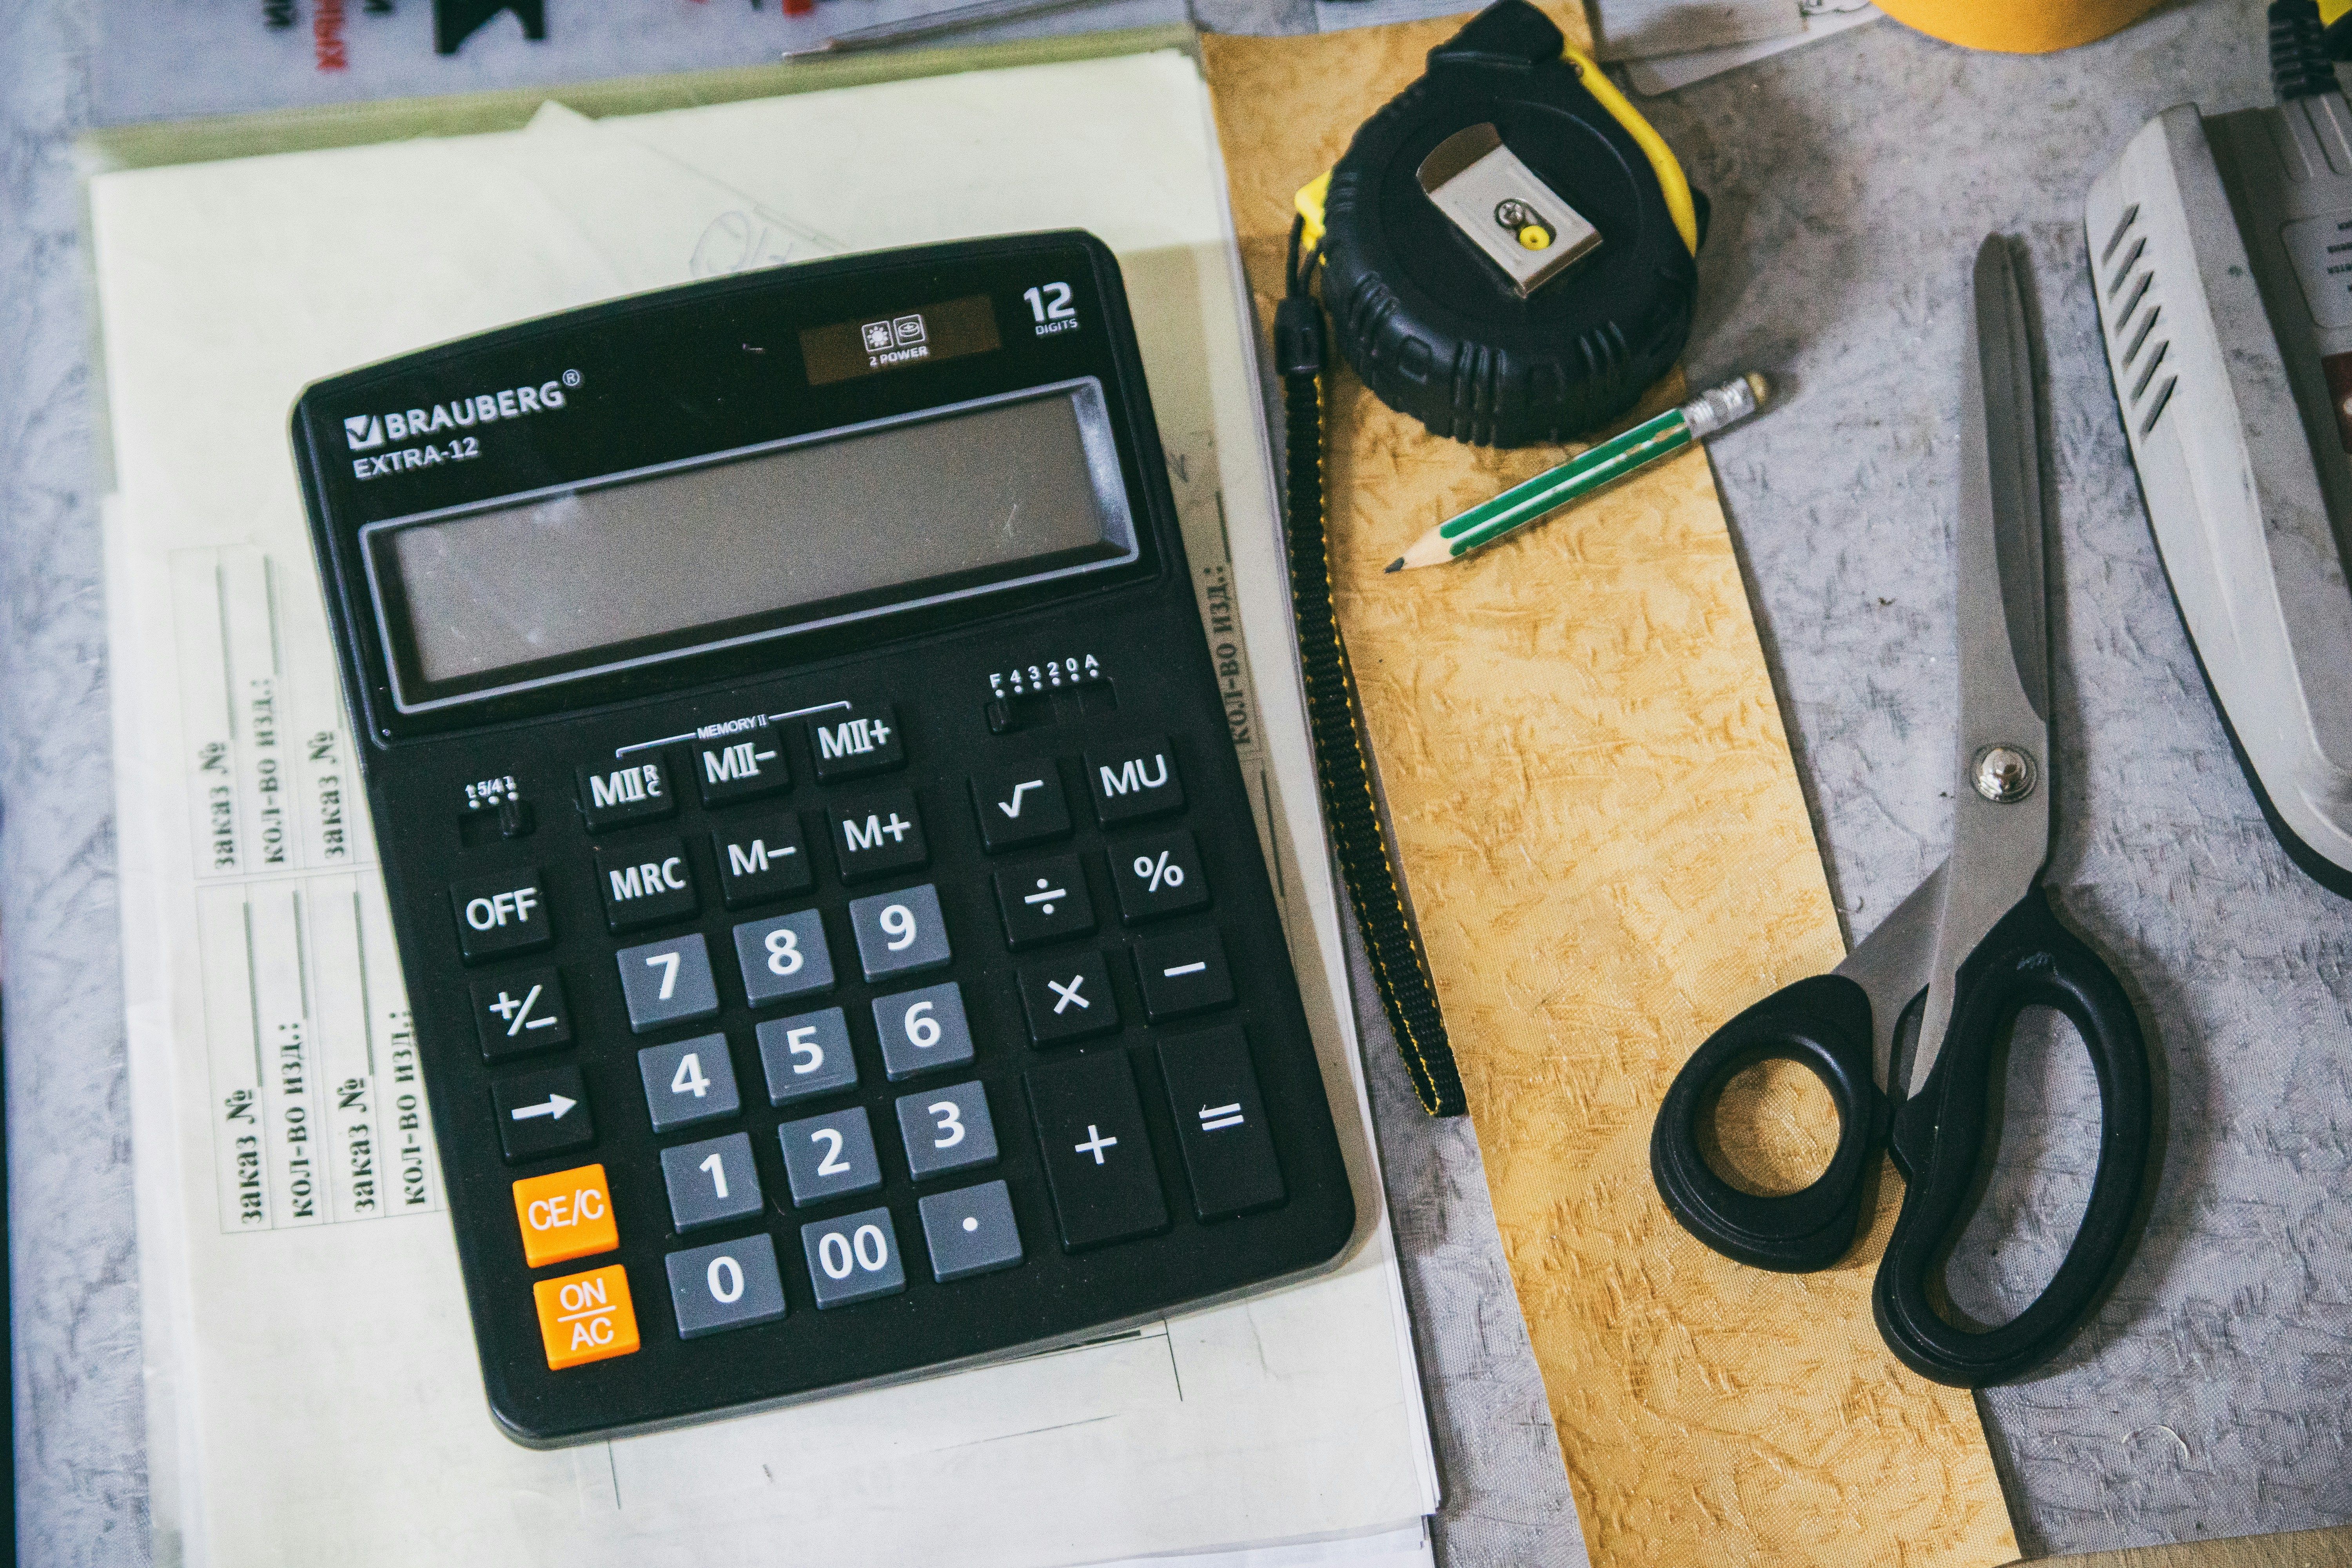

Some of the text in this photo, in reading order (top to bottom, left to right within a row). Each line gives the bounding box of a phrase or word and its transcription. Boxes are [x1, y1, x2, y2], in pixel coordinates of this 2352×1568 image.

[1024, 281, 1075, 322] 12
[1035, 318, 1078, 336] DIGITS
[869, 346, 928, 367] 2 POWER
[352, 436, 479, 479] EXTRA-12
[989, 654, 1098, 688] F 4 3 2 0 A
[697, 716, 756, 739] MEMORY
[1100, 754, 1167, 797] MU
[843, 813, 911, 851] M+
[609, 857, 686, 901] MRC
[466, 887, 537, 930] OFF
[880, 904, 916, 951] 9
[764, 929, 803, 975] 8
[646, 952, 680, 1000] 7
[904, 1001, 941, 1048] 6
[786, 1026, 824, 1074] 5
[671, 1053, 710, 1098] 4
[928, 1101, 965, 1149] 3
[811, 1128, 850, 1176] 2
[699, 1153, 729, 1198] 1
[528, 1189, 604, 1231] CE/C
[818, 1224, 888, 1279] 00
[559, 1277, 607, 1311] ON
[707, 1256, 744, 1303] 0
[570, 1317, 614, 1351] AC
